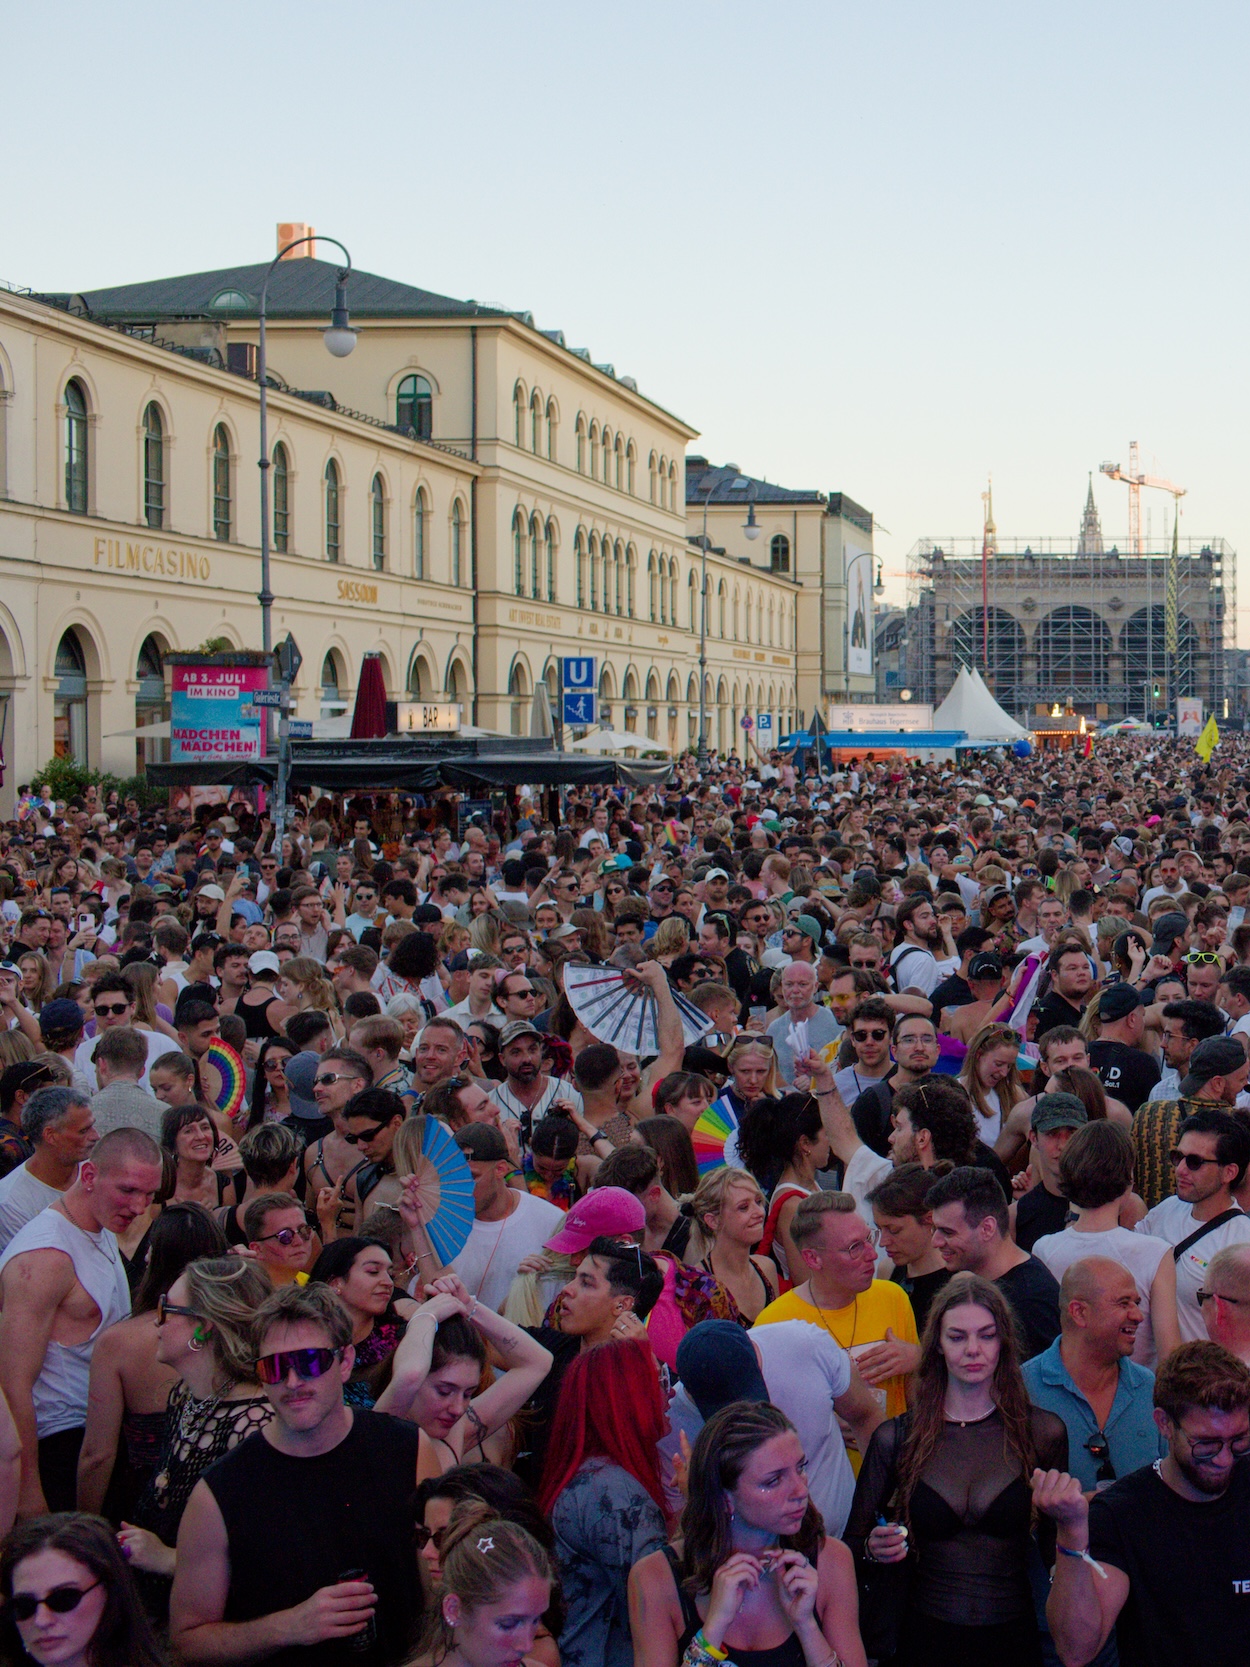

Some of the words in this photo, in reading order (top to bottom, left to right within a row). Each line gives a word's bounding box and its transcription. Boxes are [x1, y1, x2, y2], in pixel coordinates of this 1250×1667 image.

[93, 536, 211, 581] FILMCASINO
[182, 672, 198, 683] AB
[199, 673, 213, 683] 3.
[216, 673, 246, 683] JULI
[569, 661, 588, 684] U
[189, 688, 203, 697] IM
[206, 687, 237, 697] KINO
[423, 706, 439, 728] BAR
[759, 716, 768, 728] P
[173, 727, 241, 741] MÄDCHEN
[180, 739, 257, 753] MÄDCHEN!
